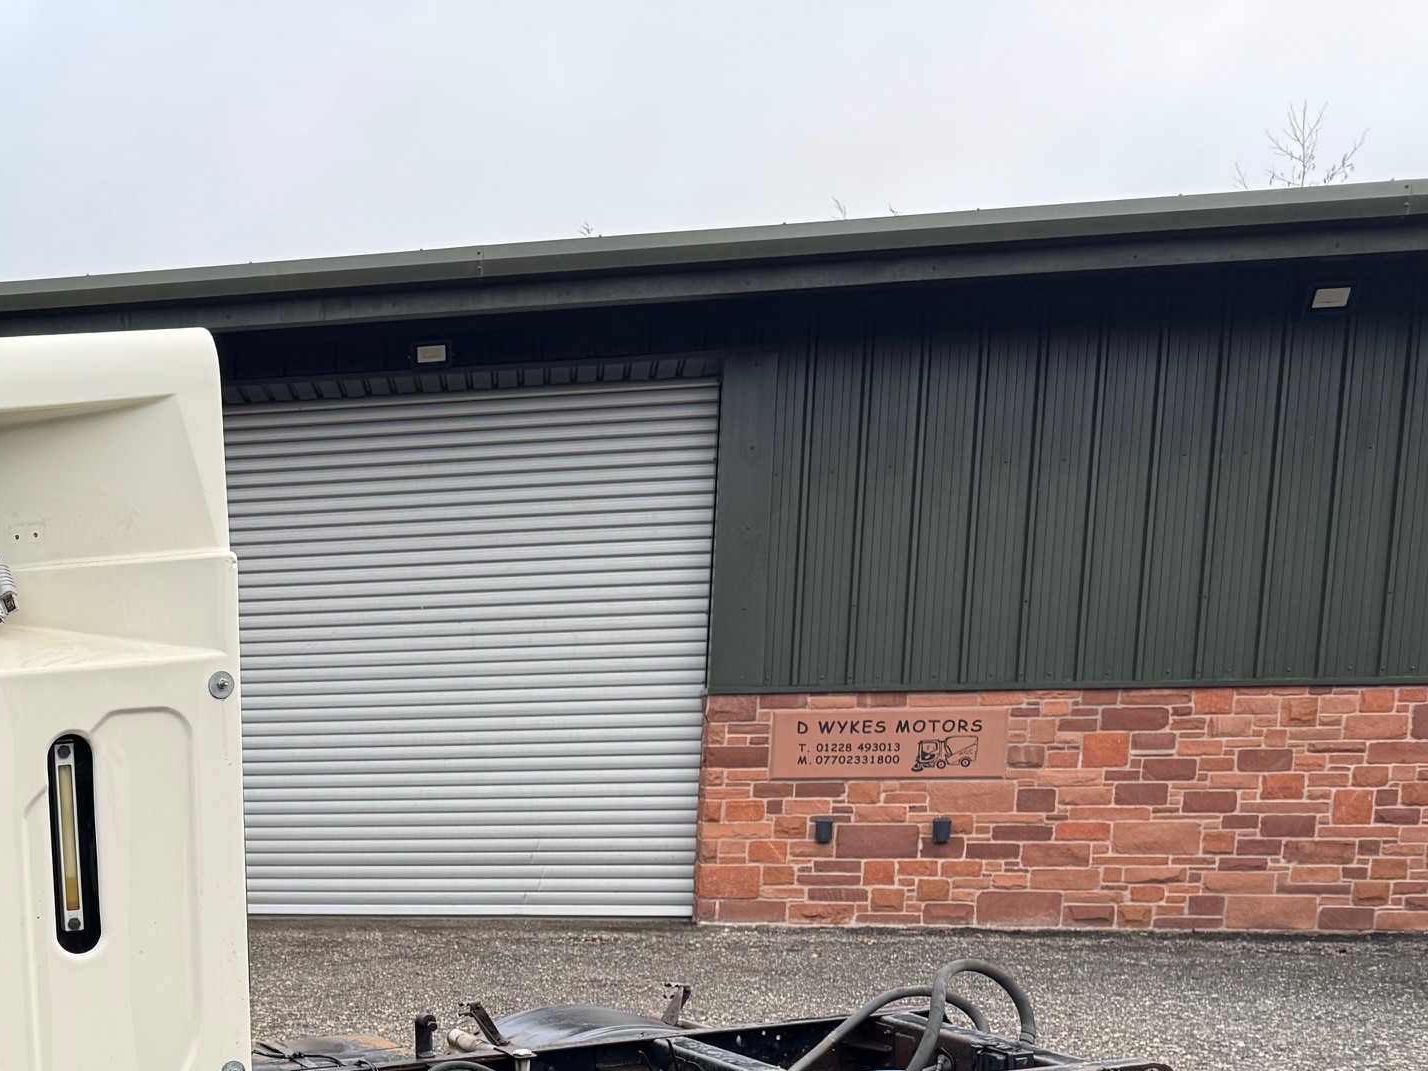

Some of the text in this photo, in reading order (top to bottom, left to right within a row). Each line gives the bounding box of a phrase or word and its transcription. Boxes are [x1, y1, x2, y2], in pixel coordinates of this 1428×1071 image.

[797, 719, 984, 735] D WYKES MOTORS
[798, 742, 901, 753] T. 01228 493013
[797, 755, 900, 766] M. 07702331800
